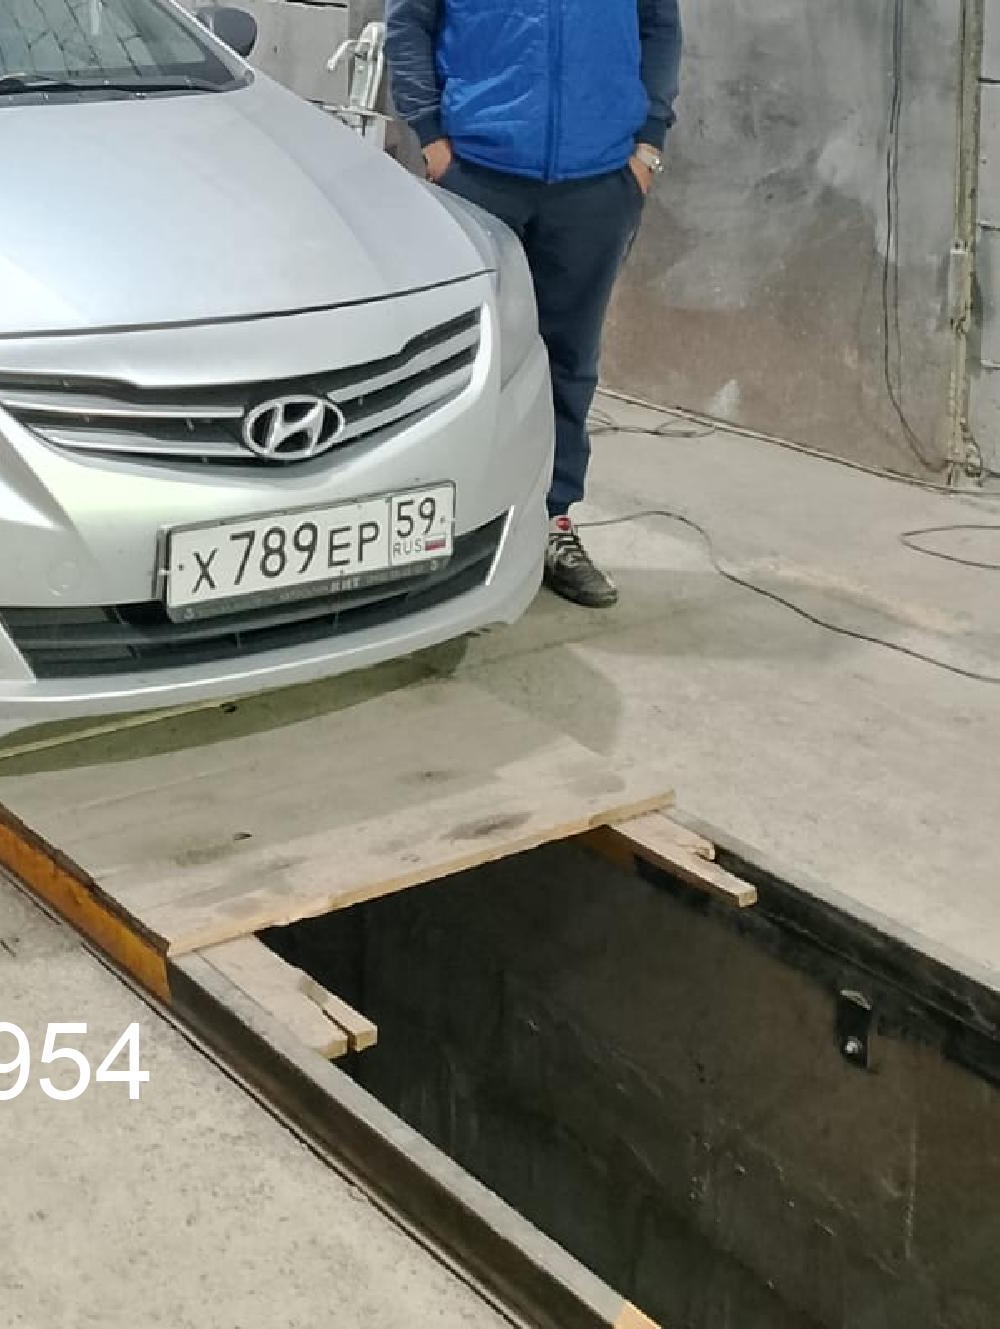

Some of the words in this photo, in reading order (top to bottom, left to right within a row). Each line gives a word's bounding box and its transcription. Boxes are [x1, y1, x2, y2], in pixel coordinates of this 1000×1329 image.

[396, 497, 436, 539] 59
[190, 521, 380, 594] Х789ЕР
[392, 537, 422, 559] RUS
